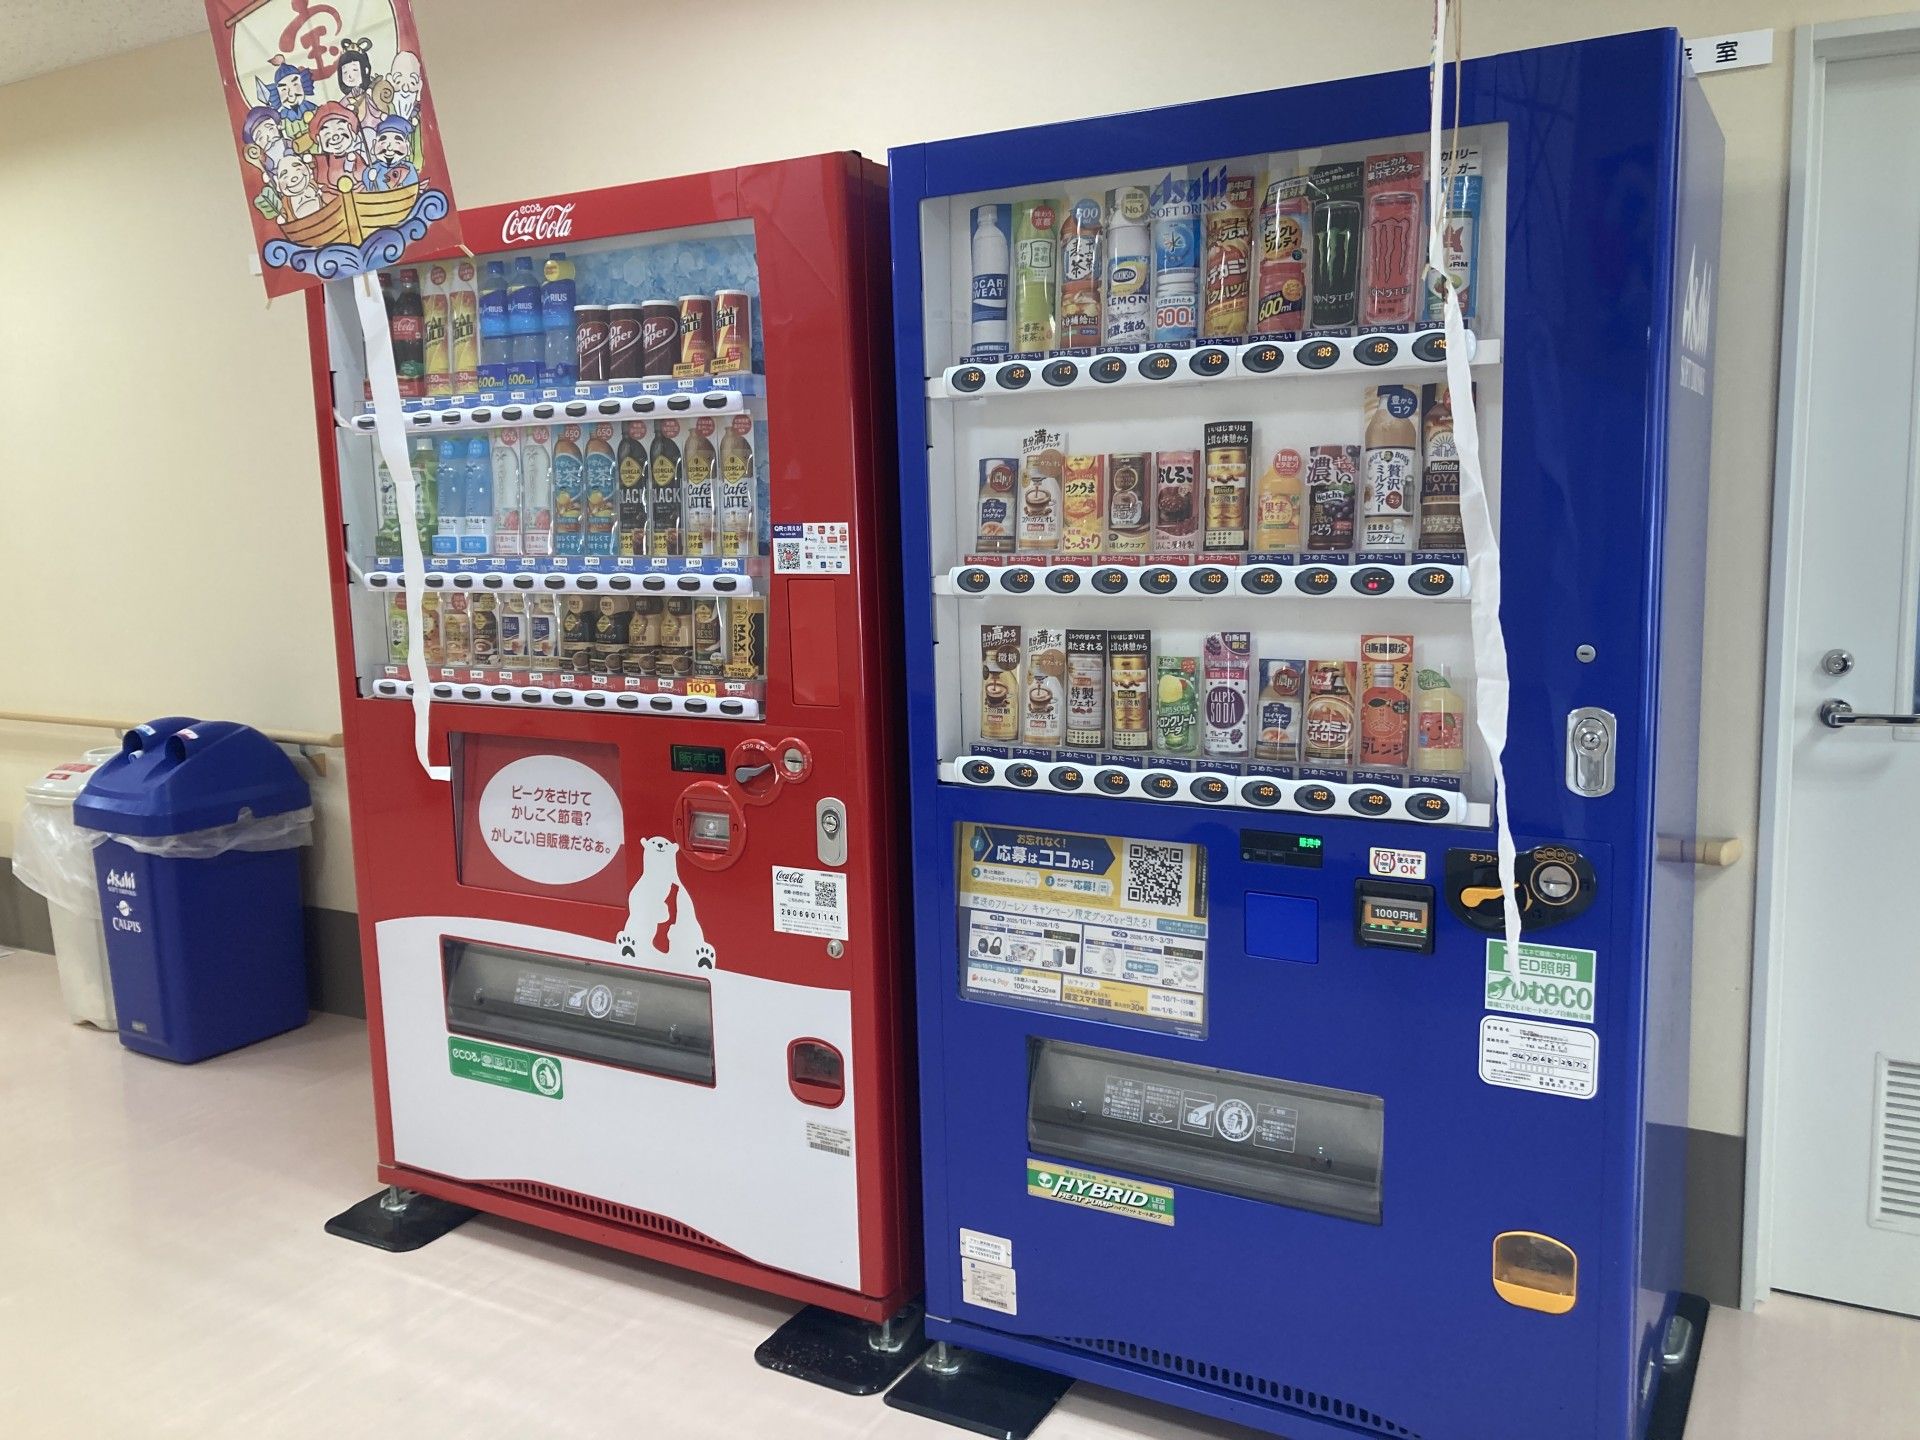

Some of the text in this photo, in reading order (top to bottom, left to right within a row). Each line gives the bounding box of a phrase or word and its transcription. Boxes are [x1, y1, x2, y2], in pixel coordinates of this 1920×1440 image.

[280, 3, 342, 80] 宝
[1715, 41, 1738, 63] 室
[1150, 165, 1228, 205] Asahi
[1125, 204, 1145, 215] No.1
[1150, 201, 1227, 219] SOFT DRINKS
[974, 278, 1006, 290] OCARI
[974, 287, 1003, 298] WEAT
[1107, 296, 1148, 307] LEMON
[1317, 347, 1332, 357] 180
[1374, 342, 1389, 353] 180
[1208, 355, 1222, 365] 130
[1262, 350, 1276, 361] 130
[1106, 362, 1120, 372] 110
[1156, 358, 1170, 368] 100
[1012, 369, 1025, 379] 120
[1058, 366, 1071, 375] 110
[968, 373, 980, 382] 130
[1393, 405, 1410, 414] コク
[1431, 463, 1459, 471] Wonda
[1387, 464, 1401, 490] 贅沢
[1425, 474, 1458, 483] ROYA
[687, 483, 711, 496] Café
[723, 482, 748, 495] Café
[1065, 482, 1096, 494] コクうま
[1424, 483, 1458, 492] LATT
[723, 496, 748, 508] LATTE
[1265, 501, 1288, 514] 果実
[972, 574, 984, 583] 100
[1017, 574, 1028, 583] 120
[1062, 574, 1074, 583] 100
[1109, 574, 1121, 583] 100
[1158, 574, 1170, 583] 100
[1208, 574, 1221, 583] 100
[1261, 574, 1274, 583] 100
[1315, 574, 1329, 583] 100
[1429, 574, 1445, 584] 130
[737, 624, 746, 653] MAX
[1364, 643, 1408, 654] 自販機限定
[998, 652, 1017, 663] 微糖
[1311, 672, 1332, 686] No.1
[1071, 687, 1094, 700] 特製
[1210, 691, 1235, 703] CALPIS
[1210, 703, 1236, 724] SODA
[1309, 732, 1347, 743] ストロング
[680, 752, 720, 765] 販売中
[978, 765, 989, 774] 120
[1021, 768, 1032, 777] 120
[1065, 772, 1077, 781] 100
[1111, 775, 1124, 785] 100
[1159, 779, 1172, 788] 100
[1209, 783, 1222, 791] 100
[512, 785, 592, 806] ピークをさけて
[1260, 787, 1274, 796] 100
[1313, 791, 1328, 800] 100
[1369, 796, 1383, 805] 100
[1426, 800, 1441, 809] 100
[512, 805, 592, 827] かしこく節電?
[1017, 834, 1066, 848] お忘れなく!
[1298, 837, 1321, 849] 販売中
[996, 845, 1094, 870] 応募はココから!
[1397, 857, 1421, 865] 使えます
[1470, 853, 1498, 862] おつり・
[1400, 865, 1417, 875] OK
[107, 869, 136, 890] Asahi
[1375, 908, 1418, 921] 1000円札
[112, 917, 142, 933] CALPIS
[1519, 959, 1571, 977] ED照明
[1051, 1176, 1149, 1207] HYBRID
[1058, 1192, 1114, 1209] HEAT PUMP
